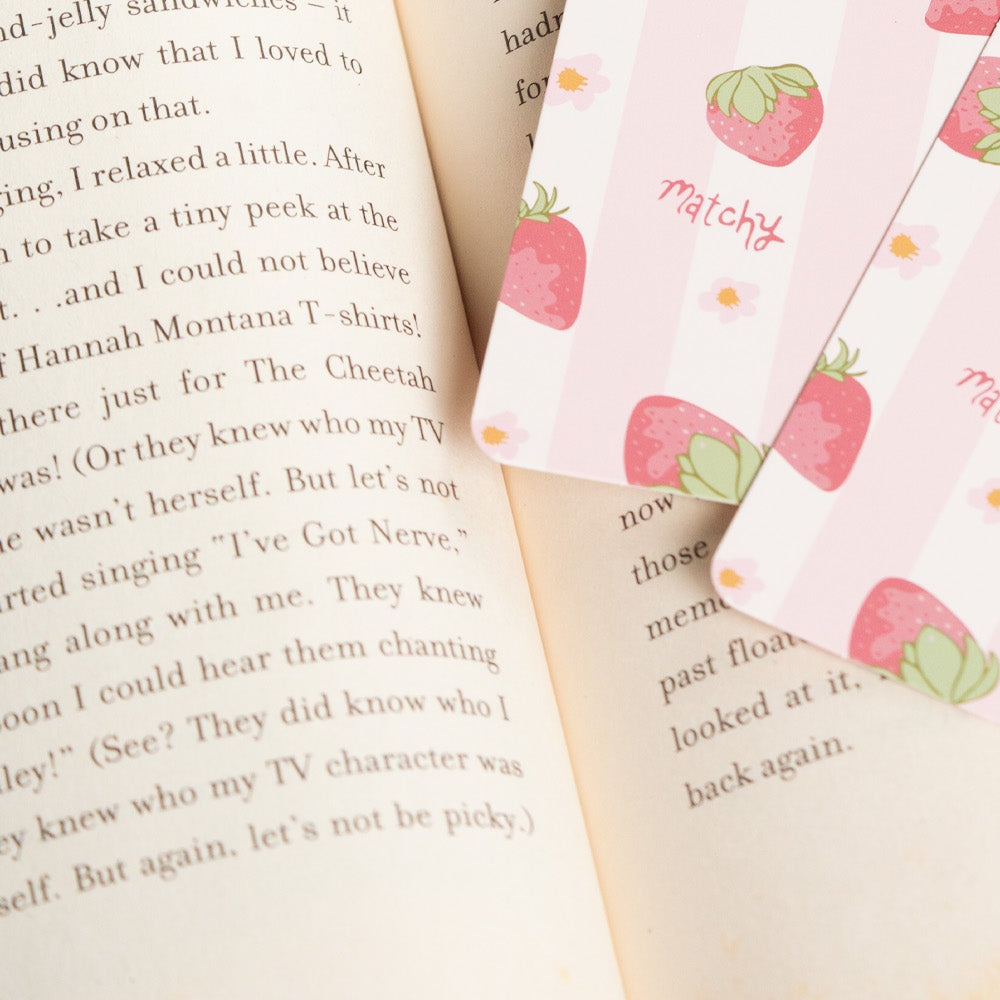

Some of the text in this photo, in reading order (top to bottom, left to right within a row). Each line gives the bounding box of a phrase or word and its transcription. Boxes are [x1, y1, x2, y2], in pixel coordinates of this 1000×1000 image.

[335, 0, 352, 23] it
[59, 53, 143, 83] know
[157, 40, 218, 64] that
[231, 36, 243, 59] I
[255, 36, 331, 66] loved
[340, 52, 362, 74] to
[92, 111, 132, 131] on
[139, 96, 209, 122] that.
[70, 141, 385, 190] I relaxed a little. After
[22, 239, 51, 257] to
[65, 218, 129, 248] take
[145, 217, 158, 232] a
[172, 204, 231, 230] tiny
[245, 194, 316, 227] peek
[328, 202, 351, 221] at
[359, 202, 398, 231] the
[136, 248, 410, 289] I could not believe
[18, 301, 421, 373] Hannah Montana T-shirts!
[0, 355, 436, 436] there just for The Cheetah
[73, 445, 125, 476] (Or
[135, 434, 199, 461] they
[208, 422, 289, 446] knew
[300, 409, 360, 434] who
[369, 419, 406, 446] my
[411, 416, 443, 444] TV
[35, 464, 459, 541] wasn't herself. But let's not
[620, 494, 673, 530] now
[82, 548, 202, 590] singing
[302, 522, 356, 547] Got
[631, 540, 709, 585] those
[66, 575, 482, 654] along with me. They knew
[74, 630, 499, 710] I could hear them chanting
[660, 655, 715, 705] past
[89, 689, 509, 768] (See? They did know who I
[671, 691, 770, 753] looked
[786, 684, 812, 708] at
[36, 749, 523, 842] knew who my TV character was
[685, 737, 852, 808] back again.
[74, 862, 126, 892] But
[248, 815, 318, 851] let's
[331, 811, 382, 836] not
[394, 802, 431, 828] be
[444, 802, 534, 839] picky.)
